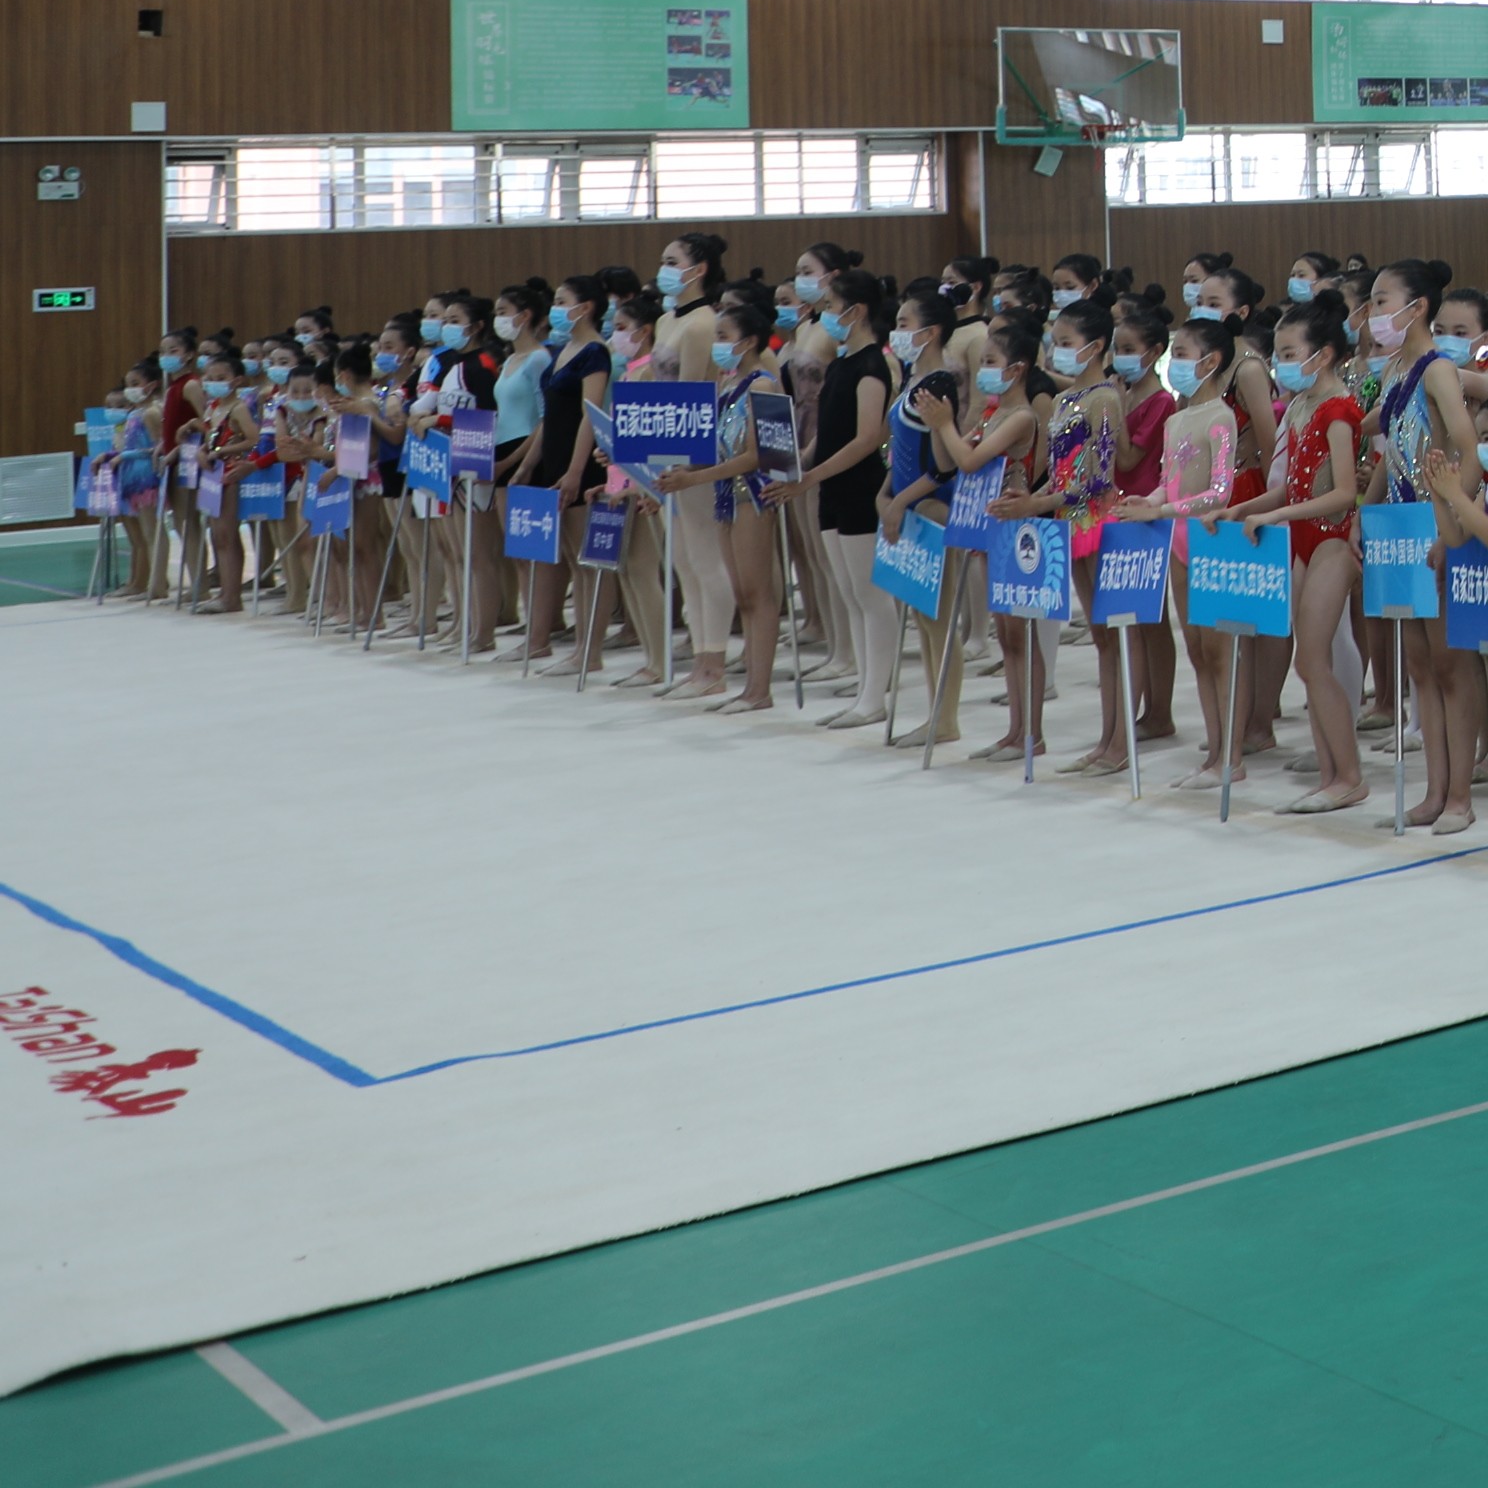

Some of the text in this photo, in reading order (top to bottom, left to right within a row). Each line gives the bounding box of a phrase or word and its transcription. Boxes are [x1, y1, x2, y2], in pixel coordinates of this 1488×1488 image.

[615, 402, 714, 438] 石家庄市育才小学
[1099, 547, 1164, 591] 石家庄市石门小学
[992, 581, 1064, 611] 河北师大附小
